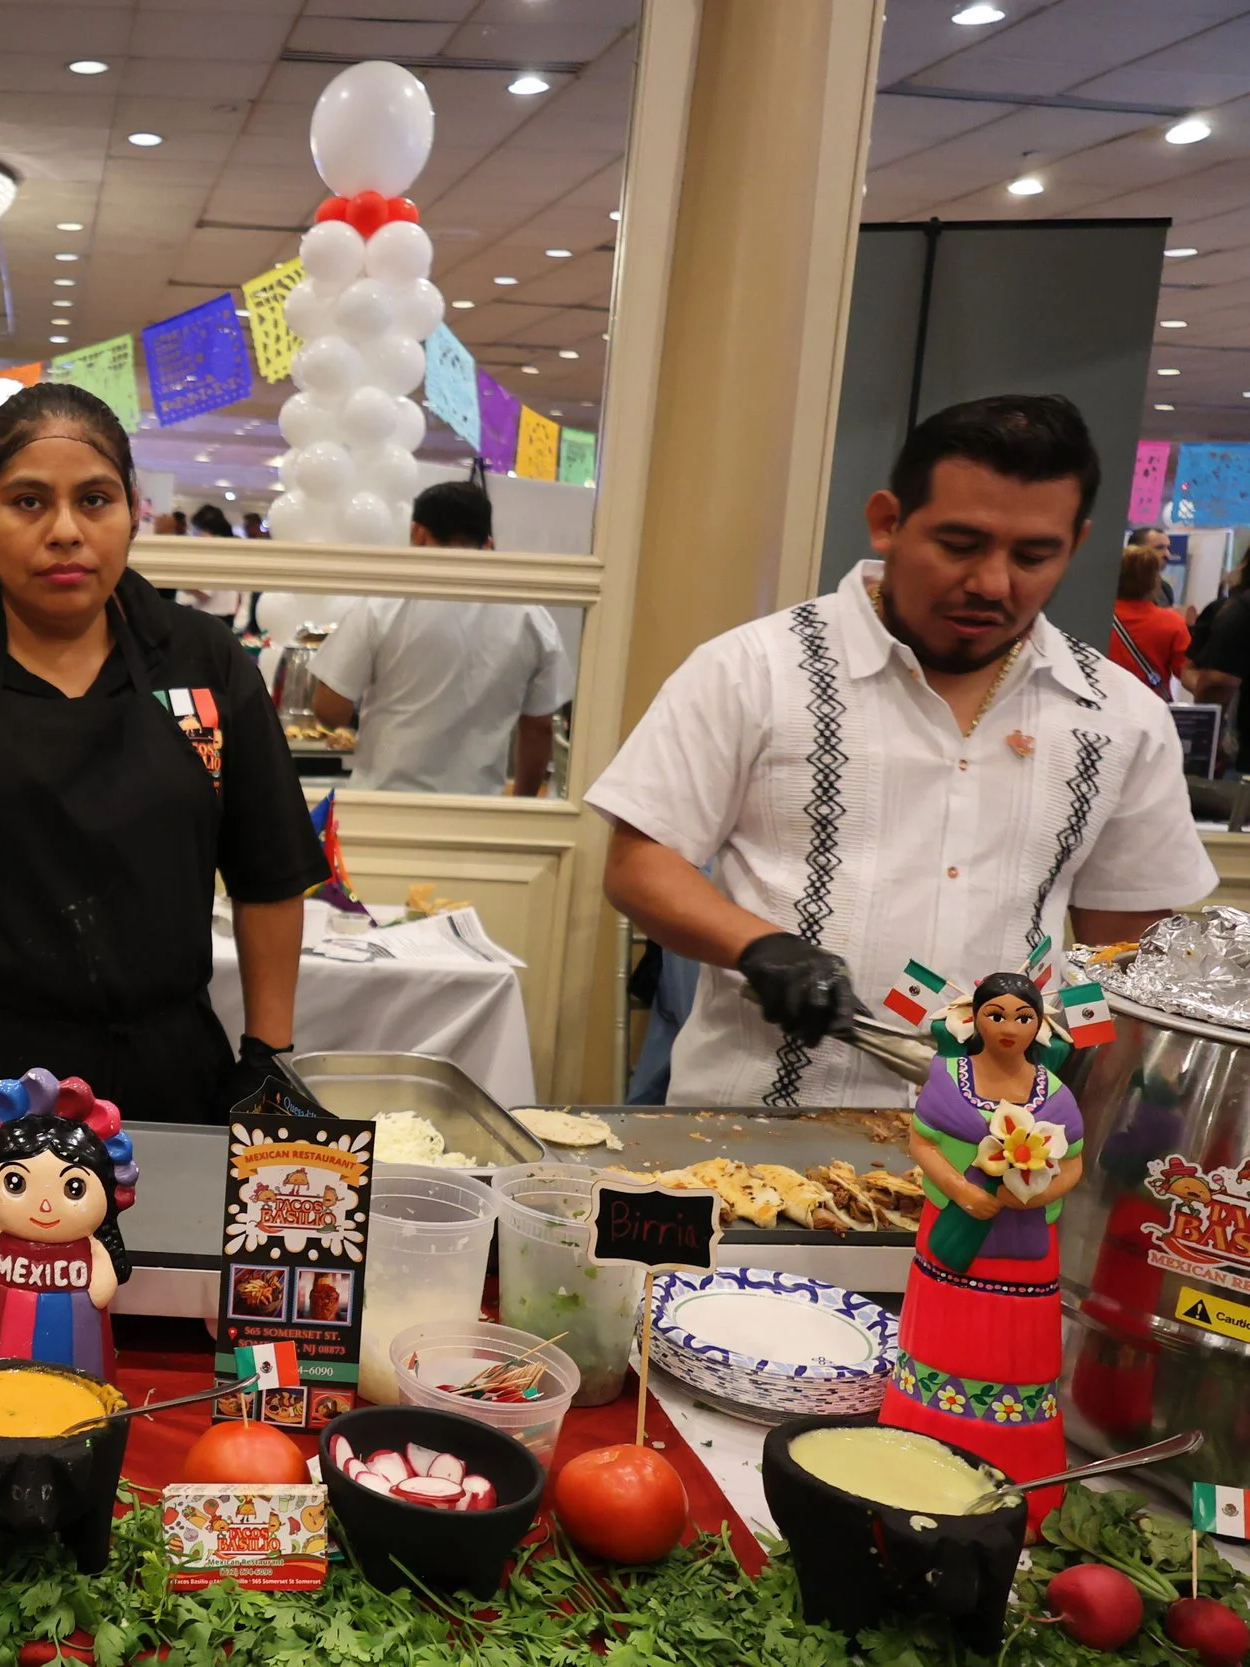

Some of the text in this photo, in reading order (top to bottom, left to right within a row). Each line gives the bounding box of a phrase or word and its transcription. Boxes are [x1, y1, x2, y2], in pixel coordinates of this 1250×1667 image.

[244, 1150, 356, 1169] MEXICAN RESTAURANT
[273, 1199, 324, 1213] TACOS
[260, 1208, 337, 1227] BASILIO
[610, 1200, 701, 1249] Birria
[1150, 1252, 1227, 1287] MEXICAN
[244, 1326, 341, 1341] 565 SOMERSET ST.
[302, 1344, 316, 1356] NJ
[228, 1527, 269, 1539] TACOS
[217, 1537, 281, 1551] BASILIO
[208, 1558, 285, 1567] Mexican Restaurant
